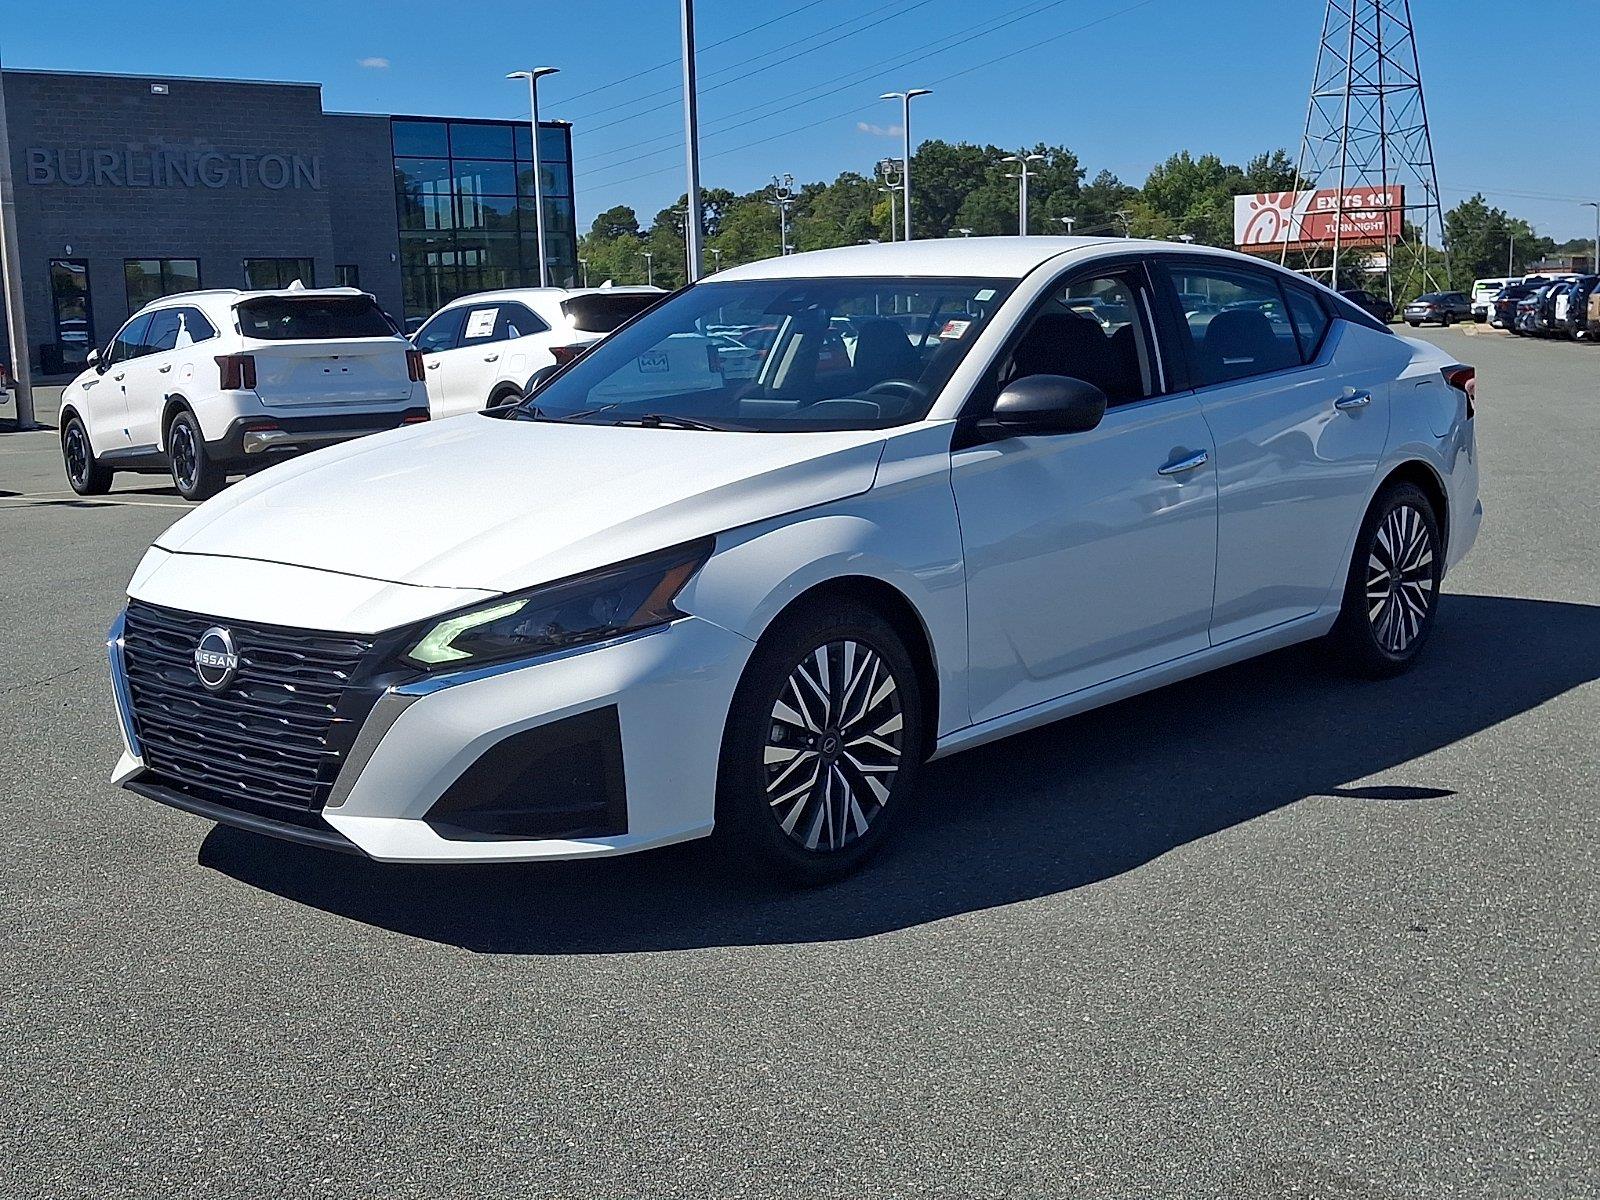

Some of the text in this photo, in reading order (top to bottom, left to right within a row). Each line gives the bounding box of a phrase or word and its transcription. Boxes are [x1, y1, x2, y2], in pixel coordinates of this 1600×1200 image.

[25, 146, 321, 190] BURLINGTON
[1317, 195, 1362, 209] EXTS
[1325, 221, 1385, 233] TURN RIGHT
[195, 652, 237, 667] NISSAN
